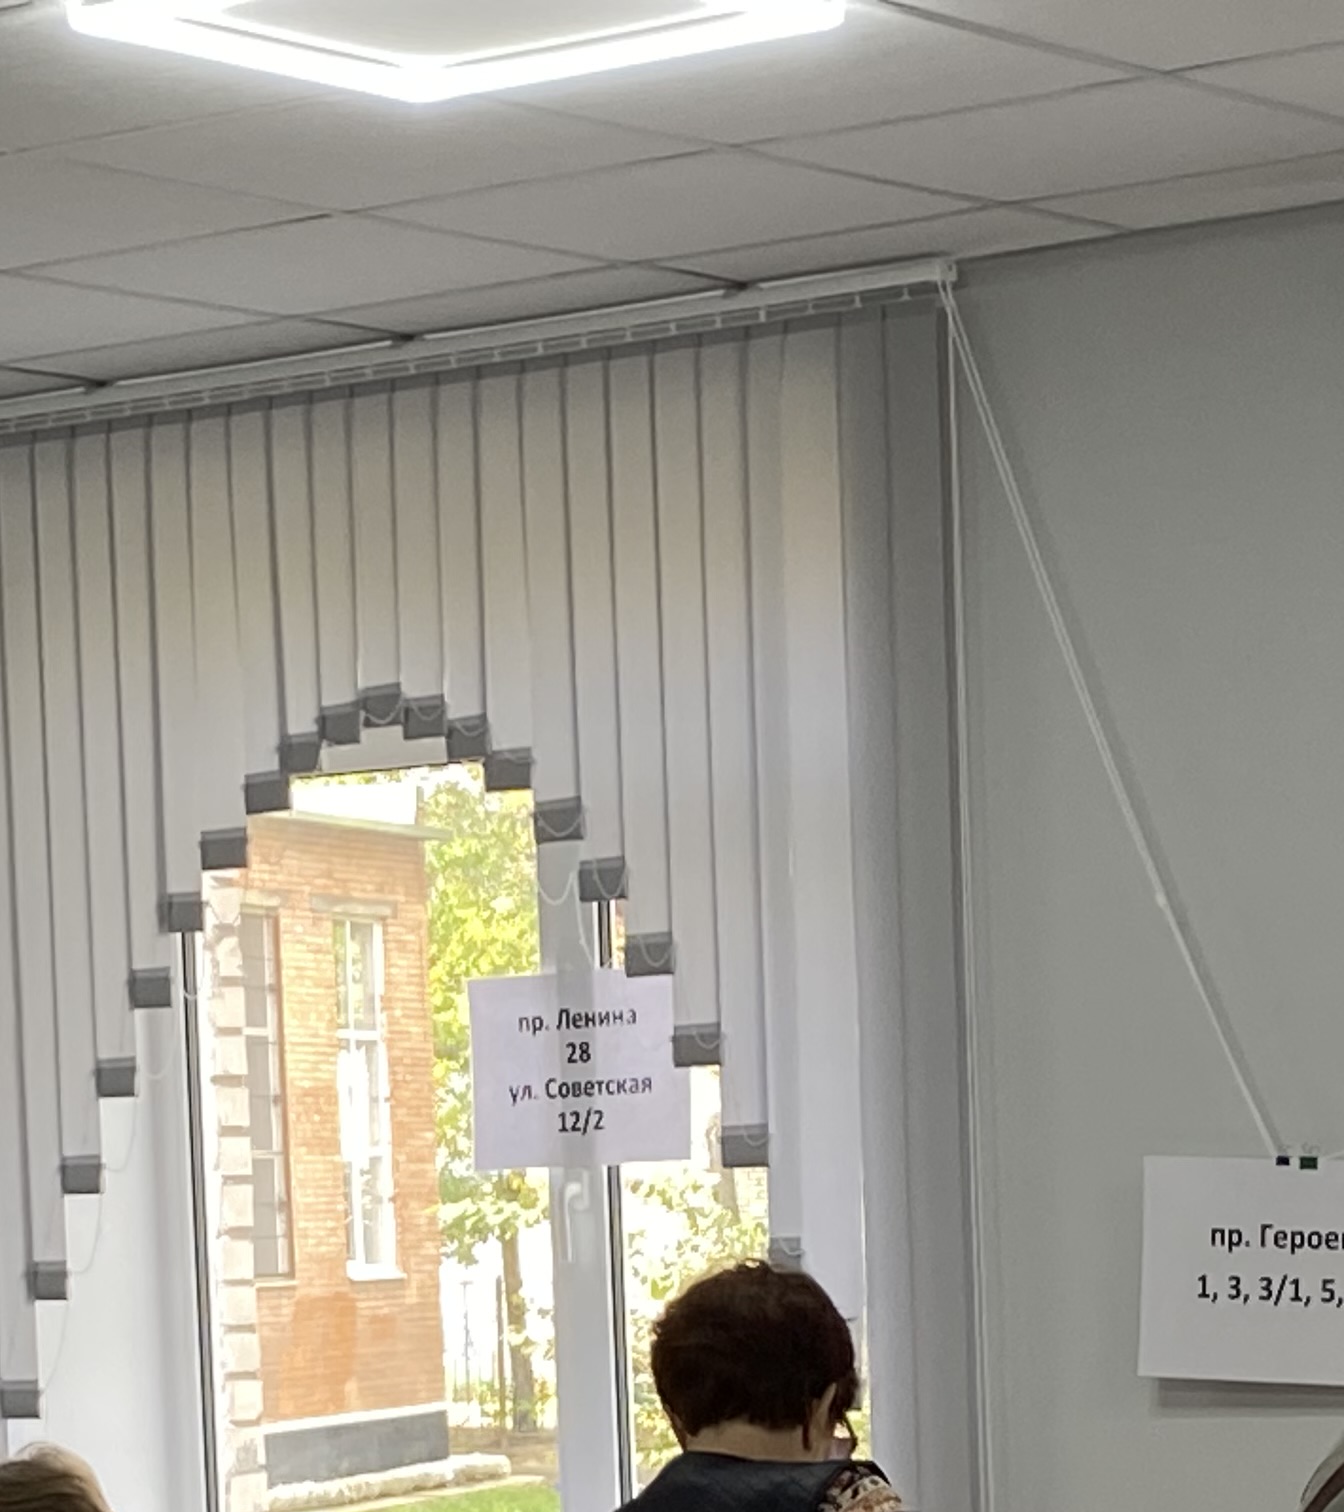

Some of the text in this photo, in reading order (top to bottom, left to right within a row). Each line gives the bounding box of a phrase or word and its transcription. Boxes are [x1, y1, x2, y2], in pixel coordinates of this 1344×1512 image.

[518, 1008, 637, 1036] пр. Ленина
[566, 1042, 591, 1064] 28
[509, 1076, 652, 1105] ул. Советская
[558, 1107, 604, 1135] 12/2
[1210, 1227, 1251, 1253] пр.
[1197, 1274, 1218, 1303] 1,
[1227, 1275, 1250, 1305] 3,
[1258, 1274, 1311, 1307] 3/1,
[1321, 1278, 1343, 1308] 5,
